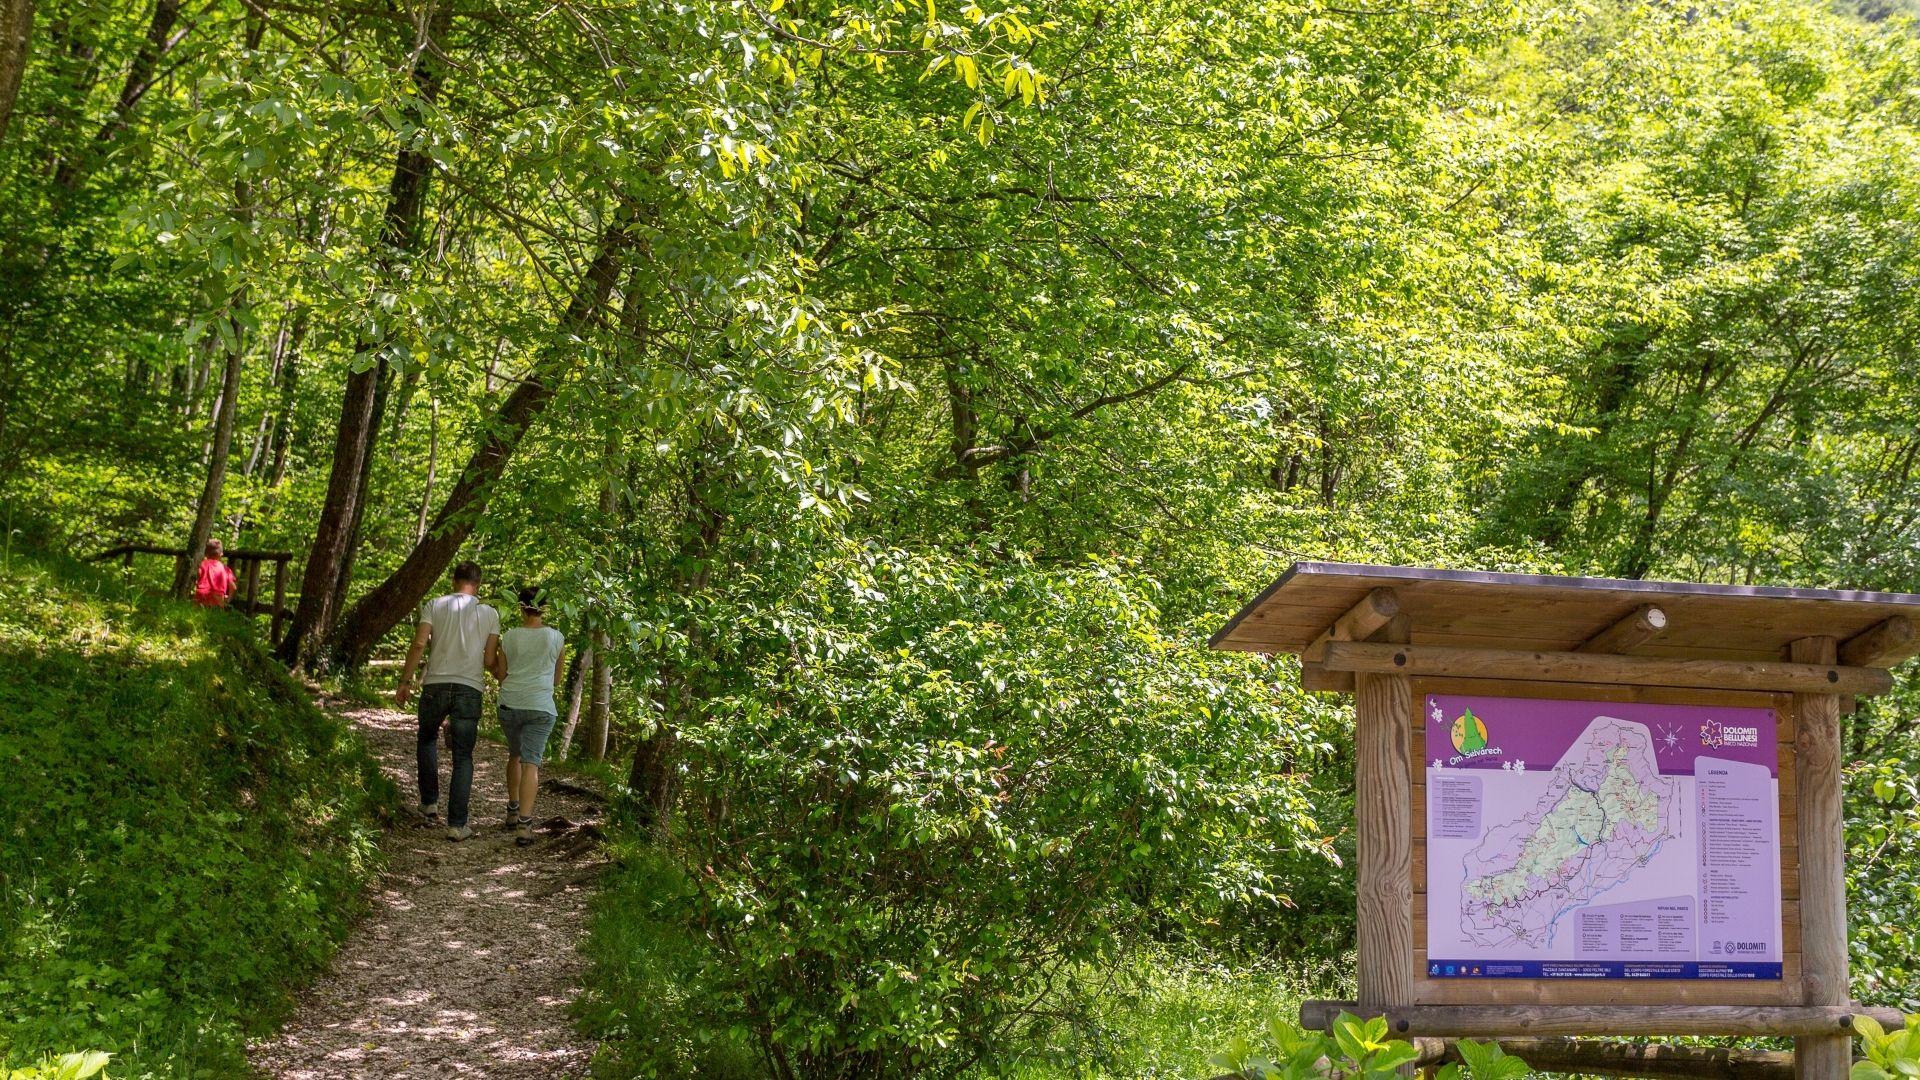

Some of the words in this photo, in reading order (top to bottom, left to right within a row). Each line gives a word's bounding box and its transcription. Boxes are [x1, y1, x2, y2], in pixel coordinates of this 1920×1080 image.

[1723, 734, 1757, 742] BELLUNESI
[1449, 755, 1464, 765] Om
[1737, 942, 1766, 950] DOLOMITI
